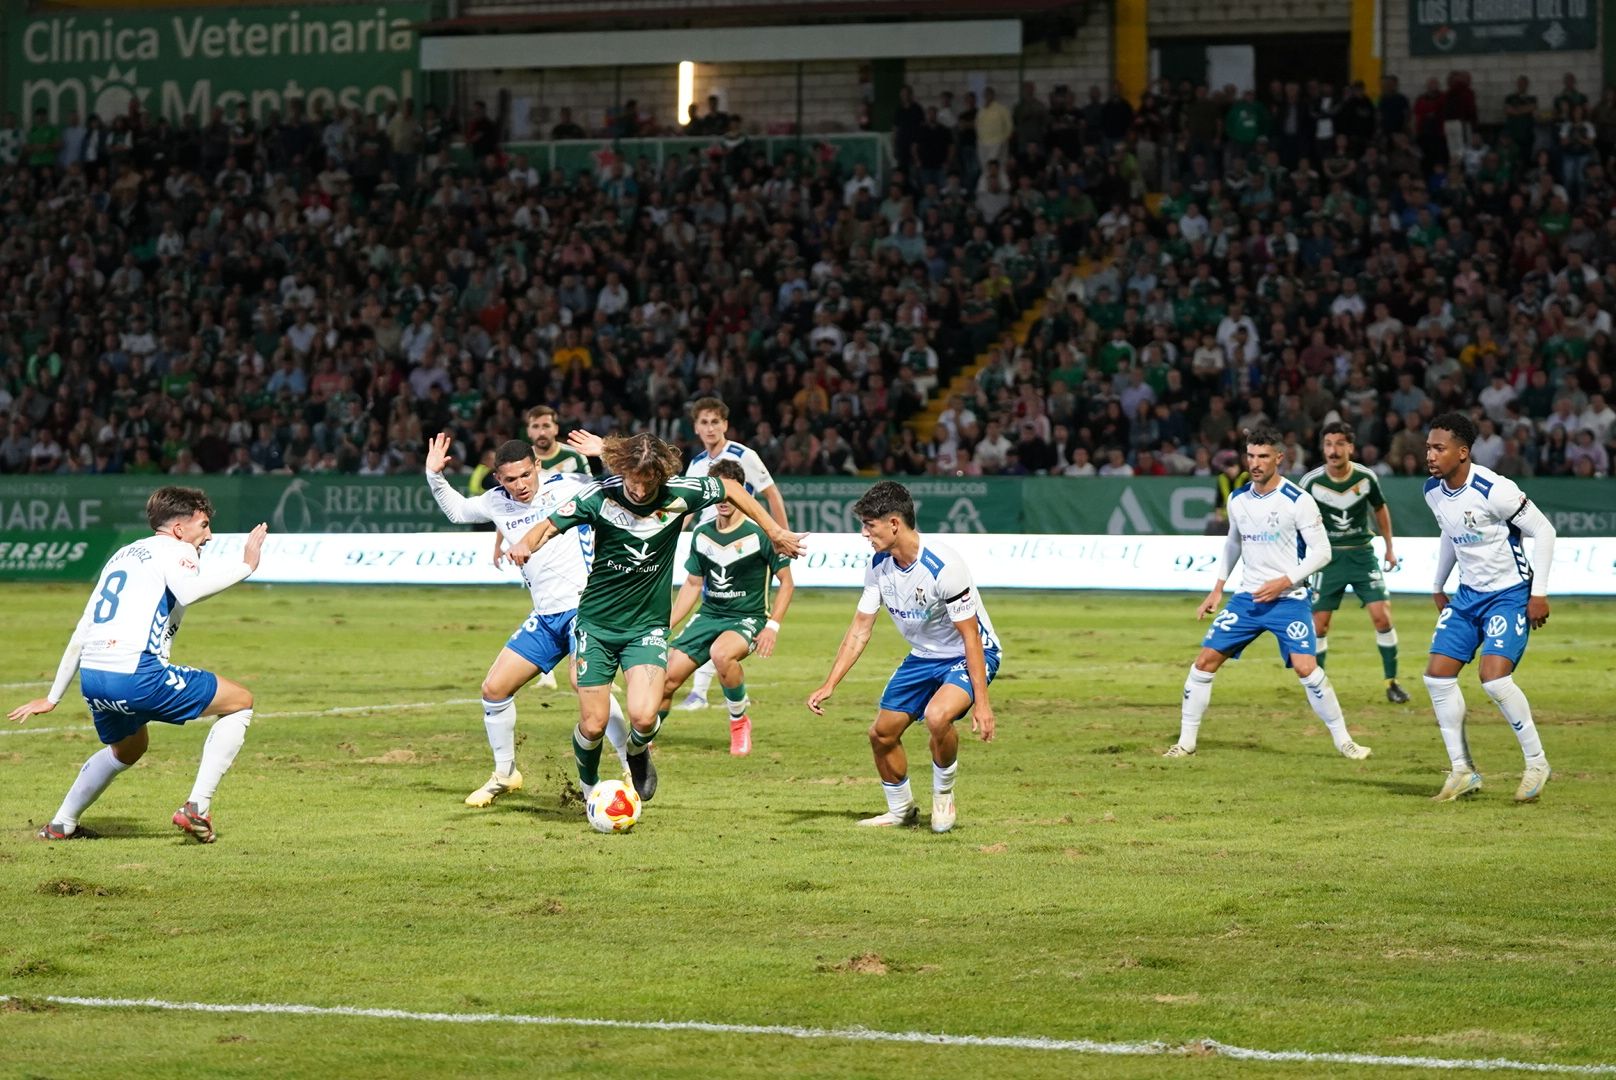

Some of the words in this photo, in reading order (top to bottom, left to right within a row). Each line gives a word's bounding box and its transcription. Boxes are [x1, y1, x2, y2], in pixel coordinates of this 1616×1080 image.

[23, 17, 159, 63] Clínica
[172, 8, 413, 59] Veterinaria
[325, 485, 437, 514] REFRIG
[0, 499, 103, 531] ARAF
[344, 549, 405, 566] 927
[807, 552, 871, 569] 038
[94, 570, 128, 624] 8
[1213, 609, 1239, 631] 22
